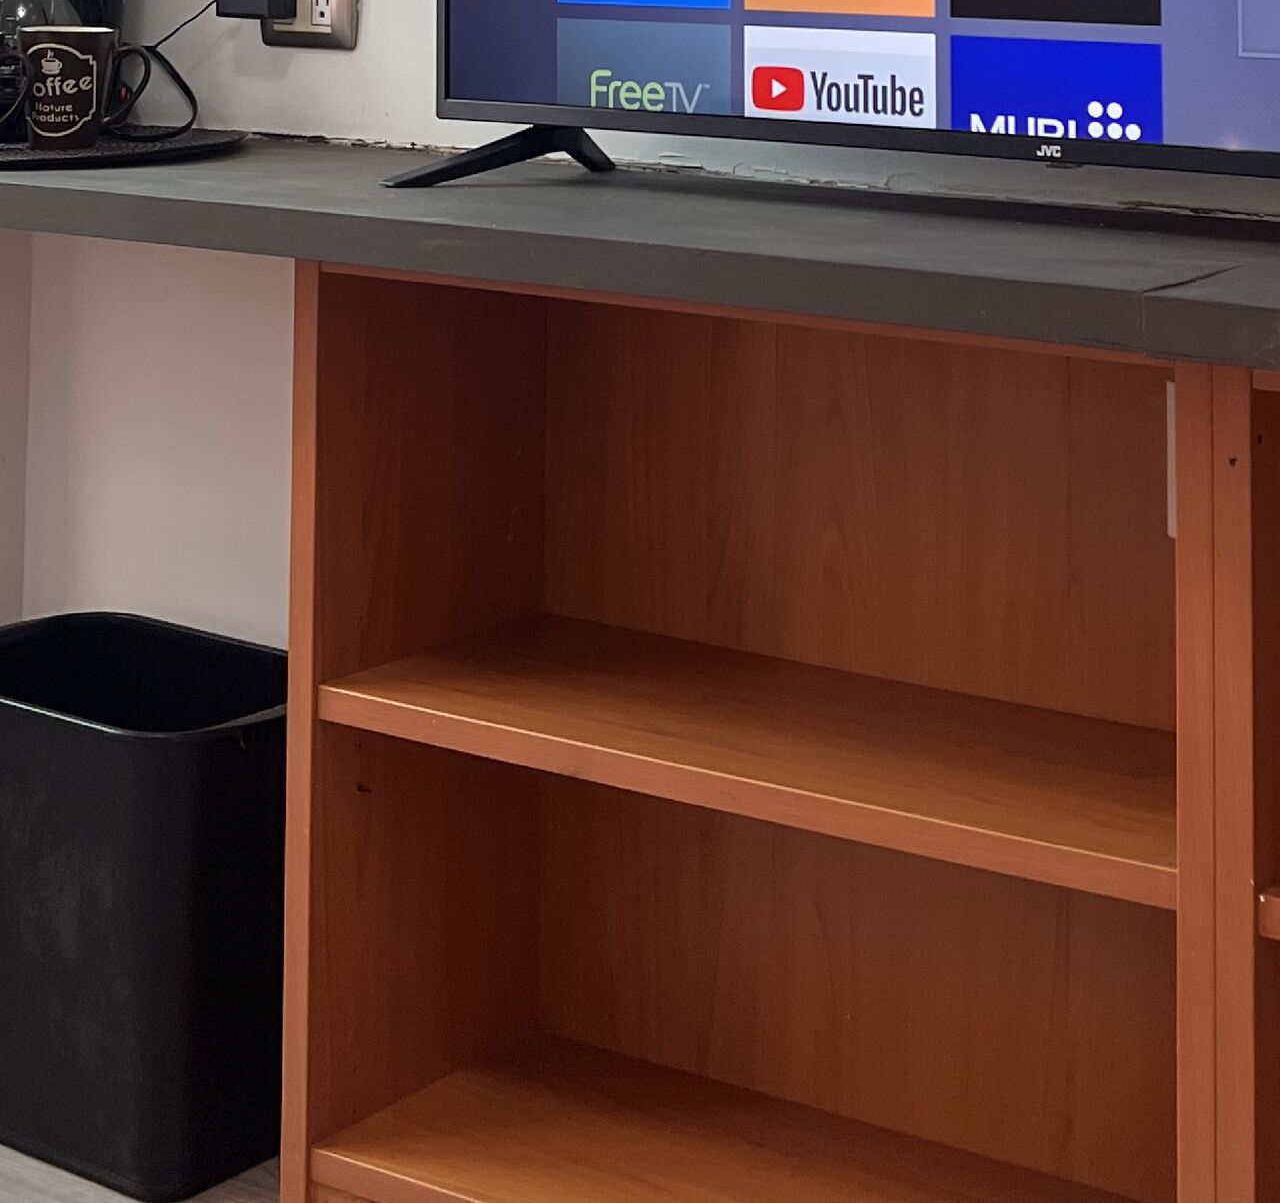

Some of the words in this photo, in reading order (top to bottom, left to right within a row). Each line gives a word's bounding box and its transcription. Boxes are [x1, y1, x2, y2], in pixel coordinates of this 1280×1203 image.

[33, 75, 93, 98] offee
[809, 71, 925, 118] YouTube
[1036, 144, 1061, 158] JVC
